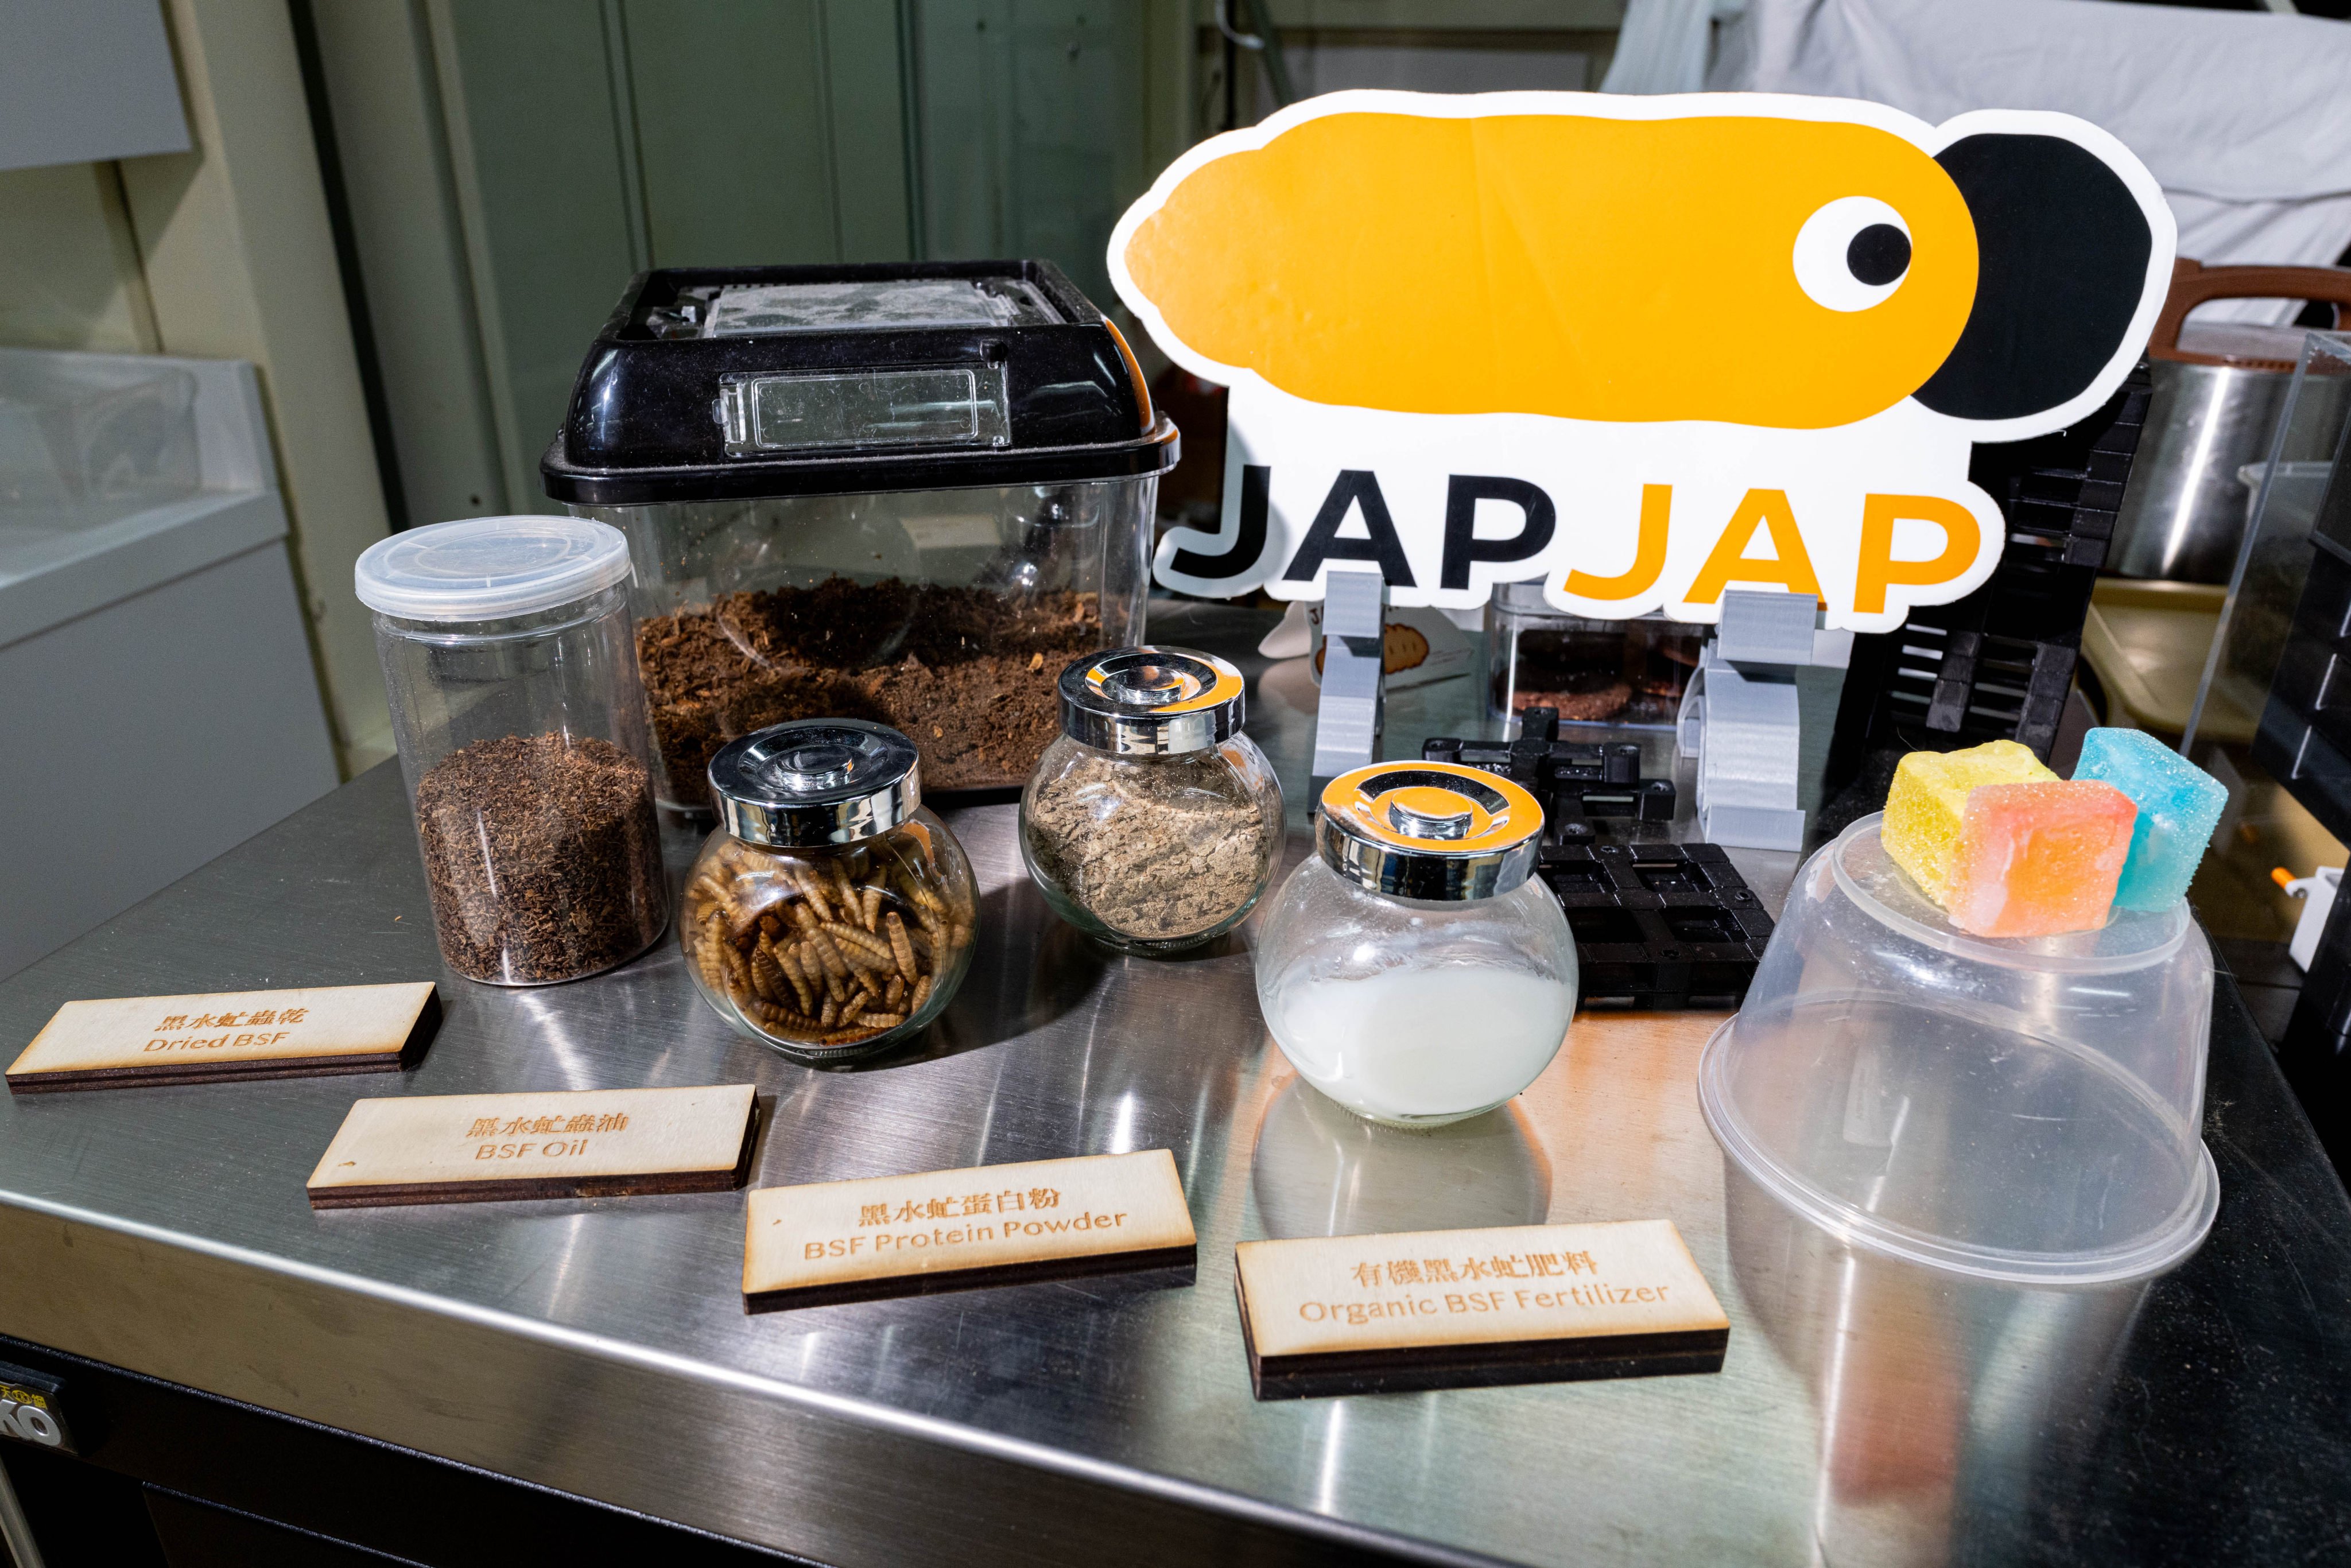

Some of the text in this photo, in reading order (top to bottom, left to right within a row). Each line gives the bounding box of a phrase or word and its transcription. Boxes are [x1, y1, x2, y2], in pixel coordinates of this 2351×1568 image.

[142, 1032, 290, 1052] Dried BSF
[475, 1139, 588, 1160] BSF Oil
[858, 1187, 1061, 1227] 黑水虻蛋白粉
[804, 1211, 1128, 1260] BSF Protein Powder
[1351, 1250, 1599, 1288] 有機黑水虻肥料
[1298, 1282, 1670, 1325] Organic BSF Fertilizer
